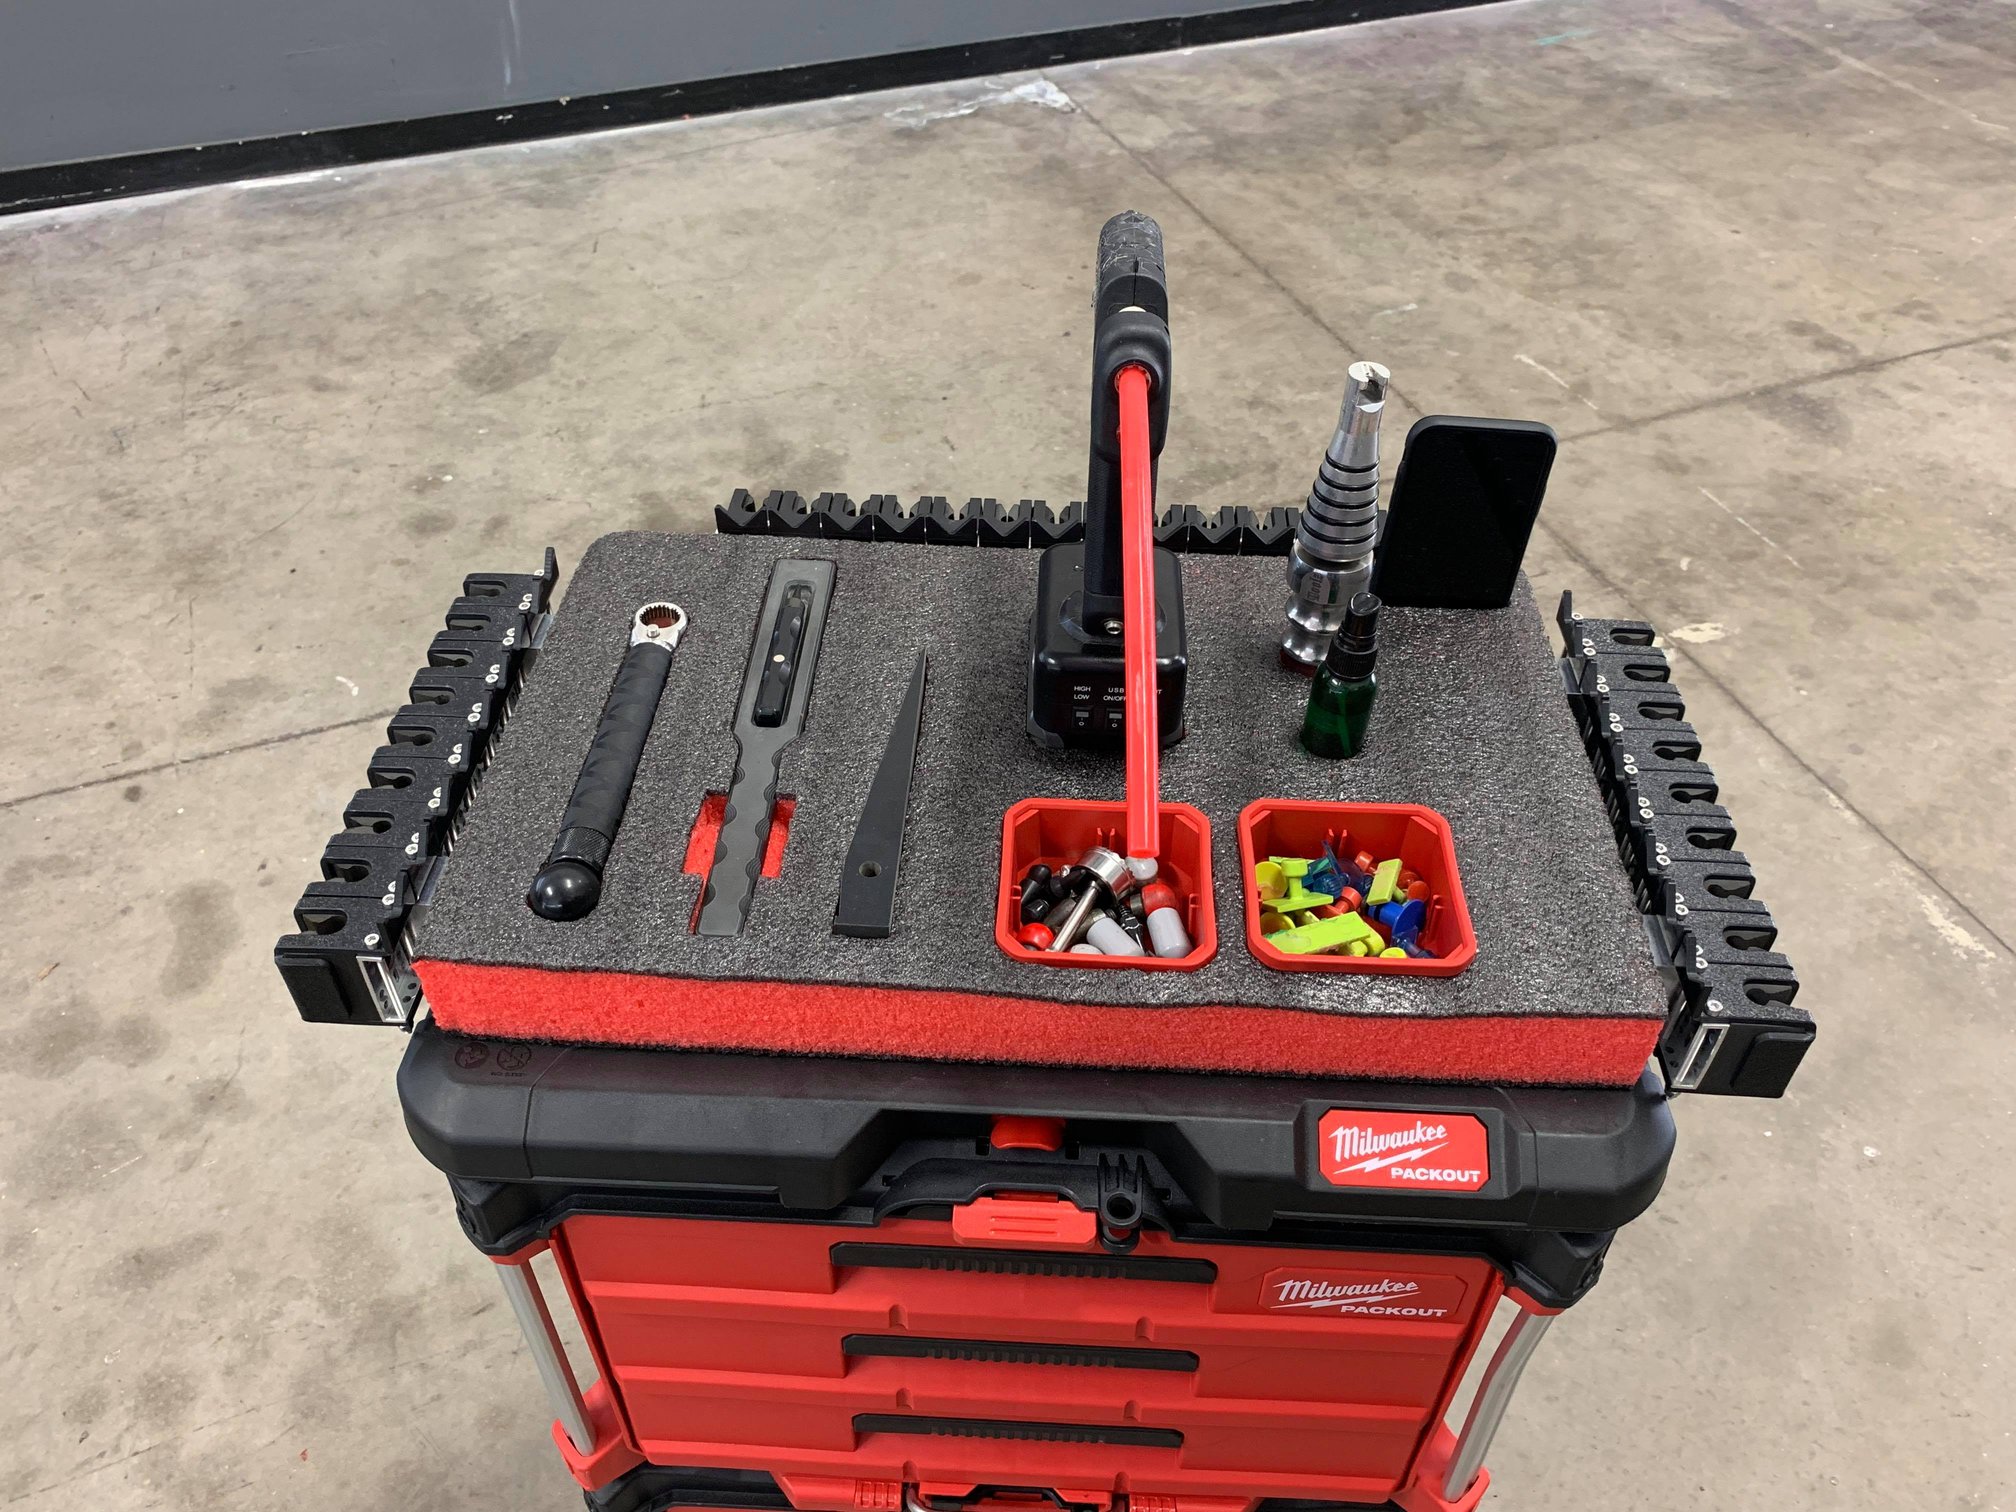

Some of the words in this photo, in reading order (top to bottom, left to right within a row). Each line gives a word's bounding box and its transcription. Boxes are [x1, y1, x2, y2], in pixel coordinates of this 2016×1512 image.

[1329, 1121, 1448, 1162] Milwaukee
[1391, 1167, 1481, 1183] PACKOUT
[1273, 1279, 1418, 1301] Milwaukee
[1340, 1305, 1448, 1317] PACKOUT
